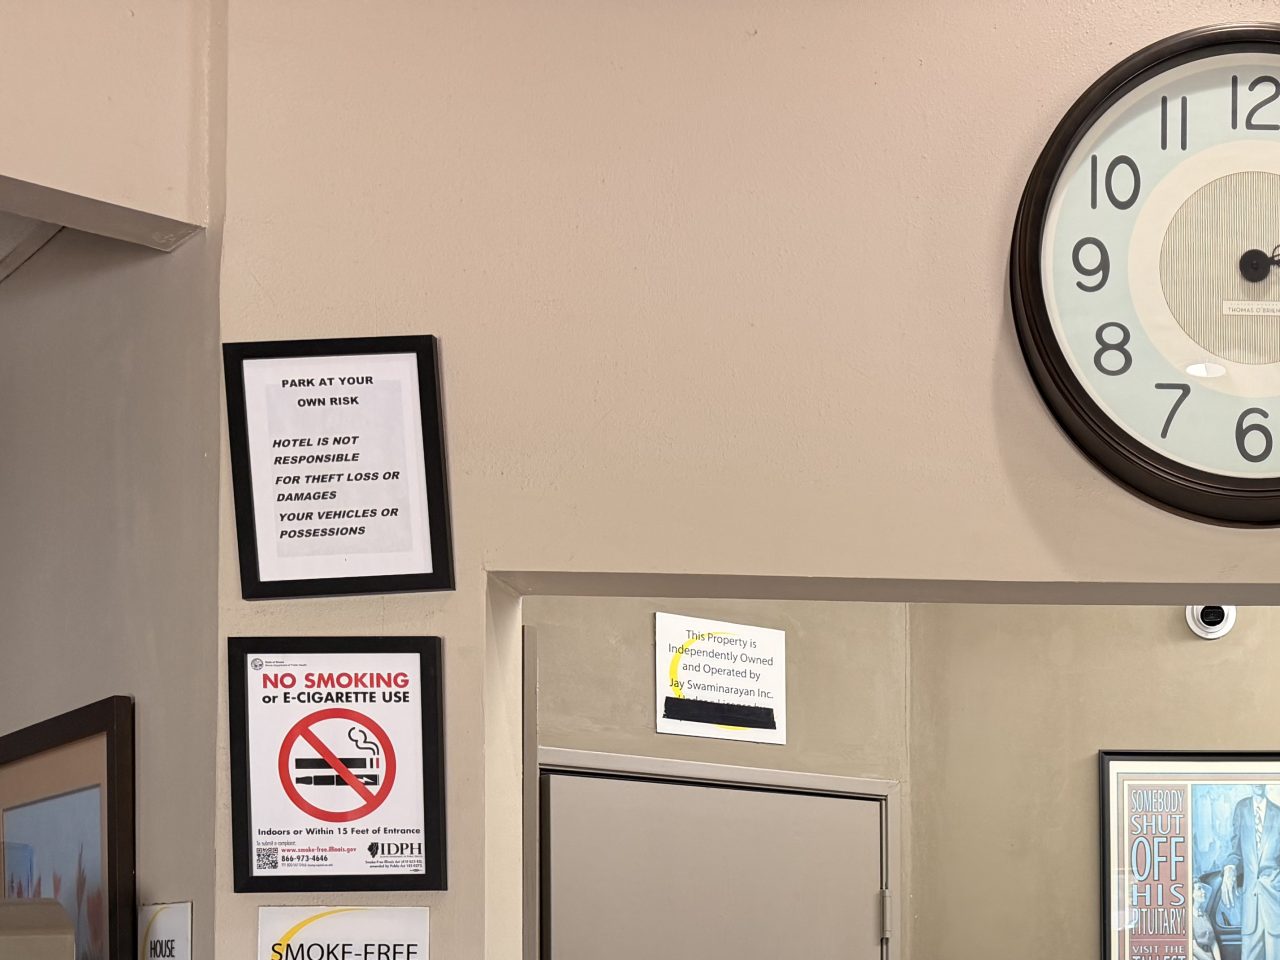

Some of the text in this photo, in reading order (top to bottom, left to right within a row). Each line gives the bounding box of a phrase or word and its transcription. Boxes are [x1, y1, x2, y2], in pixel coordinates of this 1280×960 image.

[1161, 95, 1188, 150] 11
[1090, 154, 1141, 211] 10
[1072, 237, 1110, 293] 9
[1094, 321, 1133, 377] 8
[282, 376, 374, 388] PARK AT YOUR
[297, 397, 360, 407] OWN RISK
[1154, 383, 1191, 439] 7
[272, 436, 359, 448] HOTEL IS NOT
[1235, 408, 1273, 463] 6
[274, 453, 360, 465] RESPONSIBLE
[275, 471, 400, 485] FOR THEFT LOSS OR
[277, 491, 337, 502] DAMAGES
[279, 508, 399, 522] YOUR VEHICLES OR
[280, 526, 366, 539] POSSESSIONS
[686, 630, 757, 649] This Property is
[668, 644, 773, 666] Independently Owned
[263, 673, 409, 689] NO SMOKING
[682, 664, 761, 682] and Operated by
[262, 692, 410, 704] or E-CIGARETTE USE
[669, 679, 774, 699] Jay Swaminarayan Inc.
[1131, 790, 1185, 813] SOMEBODY
[258, 828, 291, 836] Indoors
[351, 827, 369, 835] Feet
[372, 827, 381, 835] of
[384, 827, 421, 835] Entrance
[1131, 815, 1184, 835] SHUT
[381, 843, 422, 856] IDPH
[1131, 836, 1185, 882] OFF
[1132, 884, 1185, 906] HIS
[1132, 909, 1186, 936] PITUITARY!
[150, 940, 175, 958] HOUSE
[1132, 946, 1159, 954] VISIT
